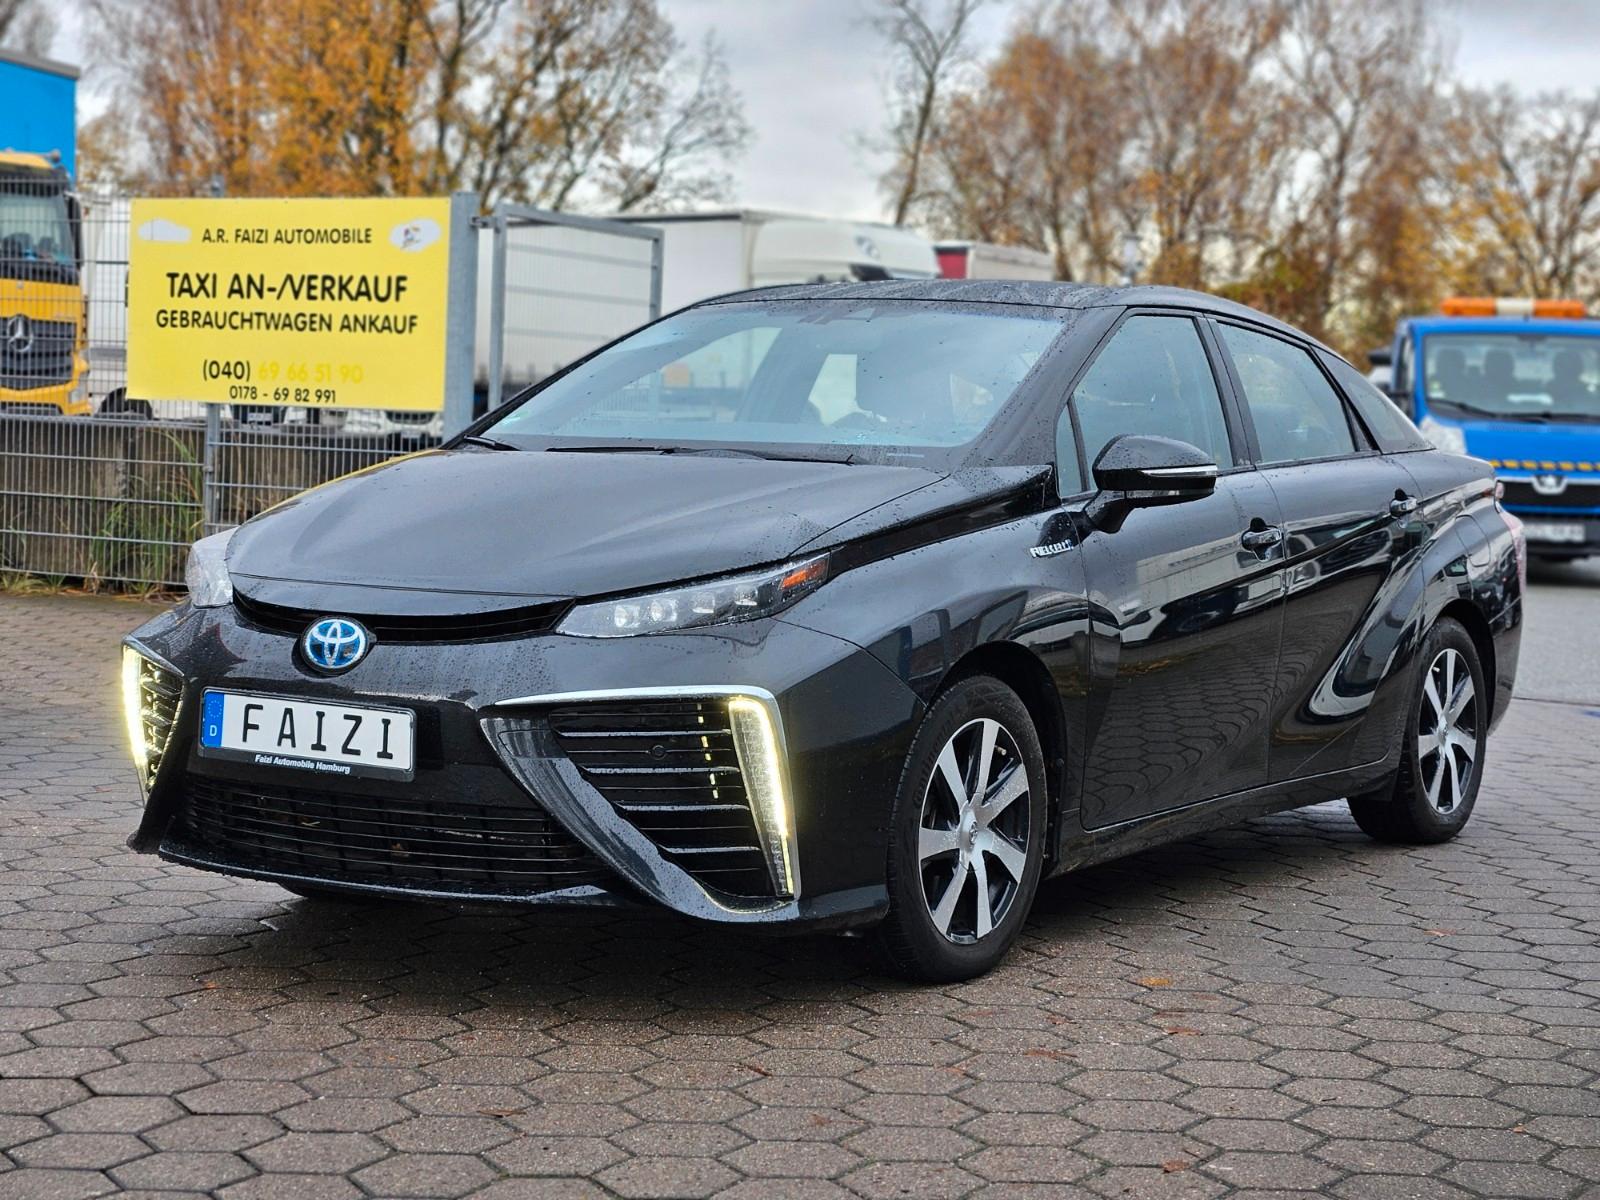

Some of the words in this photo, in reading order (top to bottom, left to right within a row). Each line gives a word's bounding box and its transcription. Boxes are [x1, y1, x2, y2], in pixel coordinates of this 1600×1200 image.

[202, 228, 229, 244] A.R.
[234, 228, 269, 244] FAIZI
[274, 228, 372, 244] AUTOMOBILE
[166, 272, 217, 299] TAXI
[156, 309, 333, 332] GEBRAUCHTWAGEN
[339, 314, 418, 334] ANKAUF
[202, 359, 250, 382] (040)
[257, 361, 281, 382] 69
[340, 364, 365, 385] 90
[229, 385, 258, 400] 0178
[273, 387, 290, 401] 69
[294, 388, 310, 402] 82
[315, 389, 337, 403] 991
[209, 725, 218, 737] D
[241, 703, 394, 760] FAIZI
[254, 754, 273, 764] Faizi
[273, 756, 315, 769] Automobile
[315, 761, 351, 775] Hamburg
